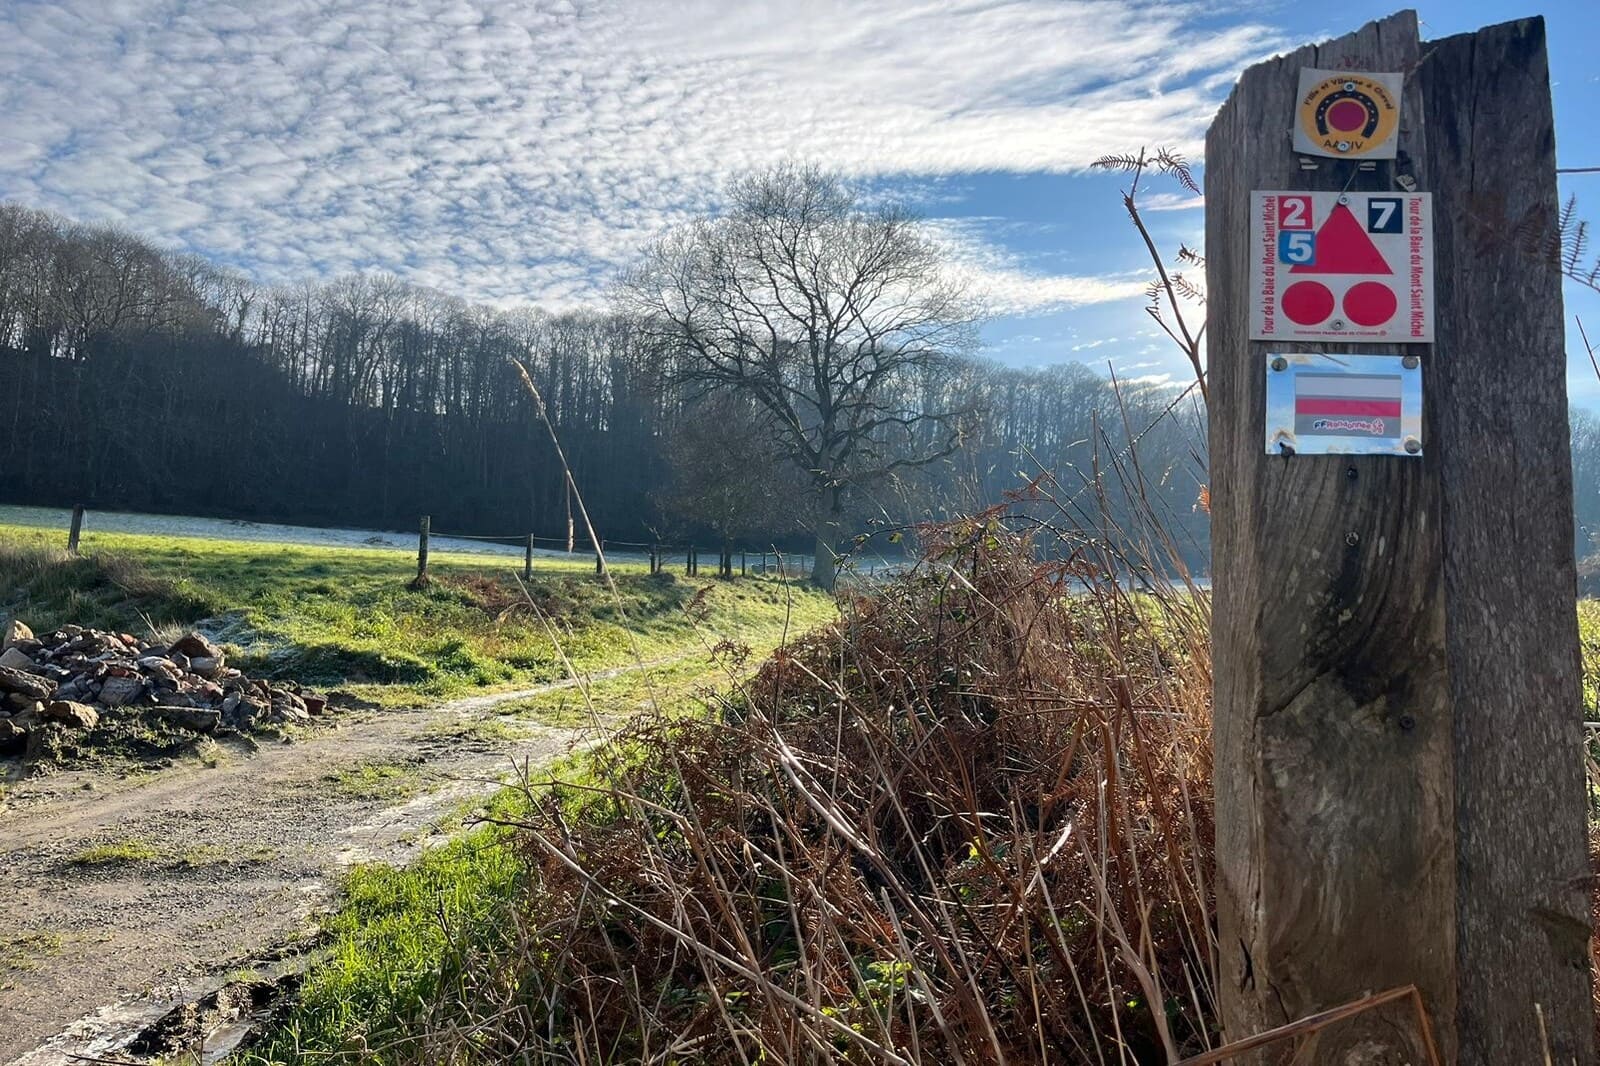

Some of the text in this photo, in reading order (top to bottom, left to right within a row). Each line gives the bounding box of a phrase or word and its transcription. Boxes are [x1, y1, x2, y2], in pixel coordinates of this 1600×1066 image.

[1283, 198, 1307, 226] 2
[1371, 202, 1396, 229] 7
[1287, 233, 1312, 262] 5
[1261, 195, 1276, 335] Tour de la Baie du Mont Saint Michel
[1410, 197, 1424, 337] Tour de la Baie du Mont Saint Michel
